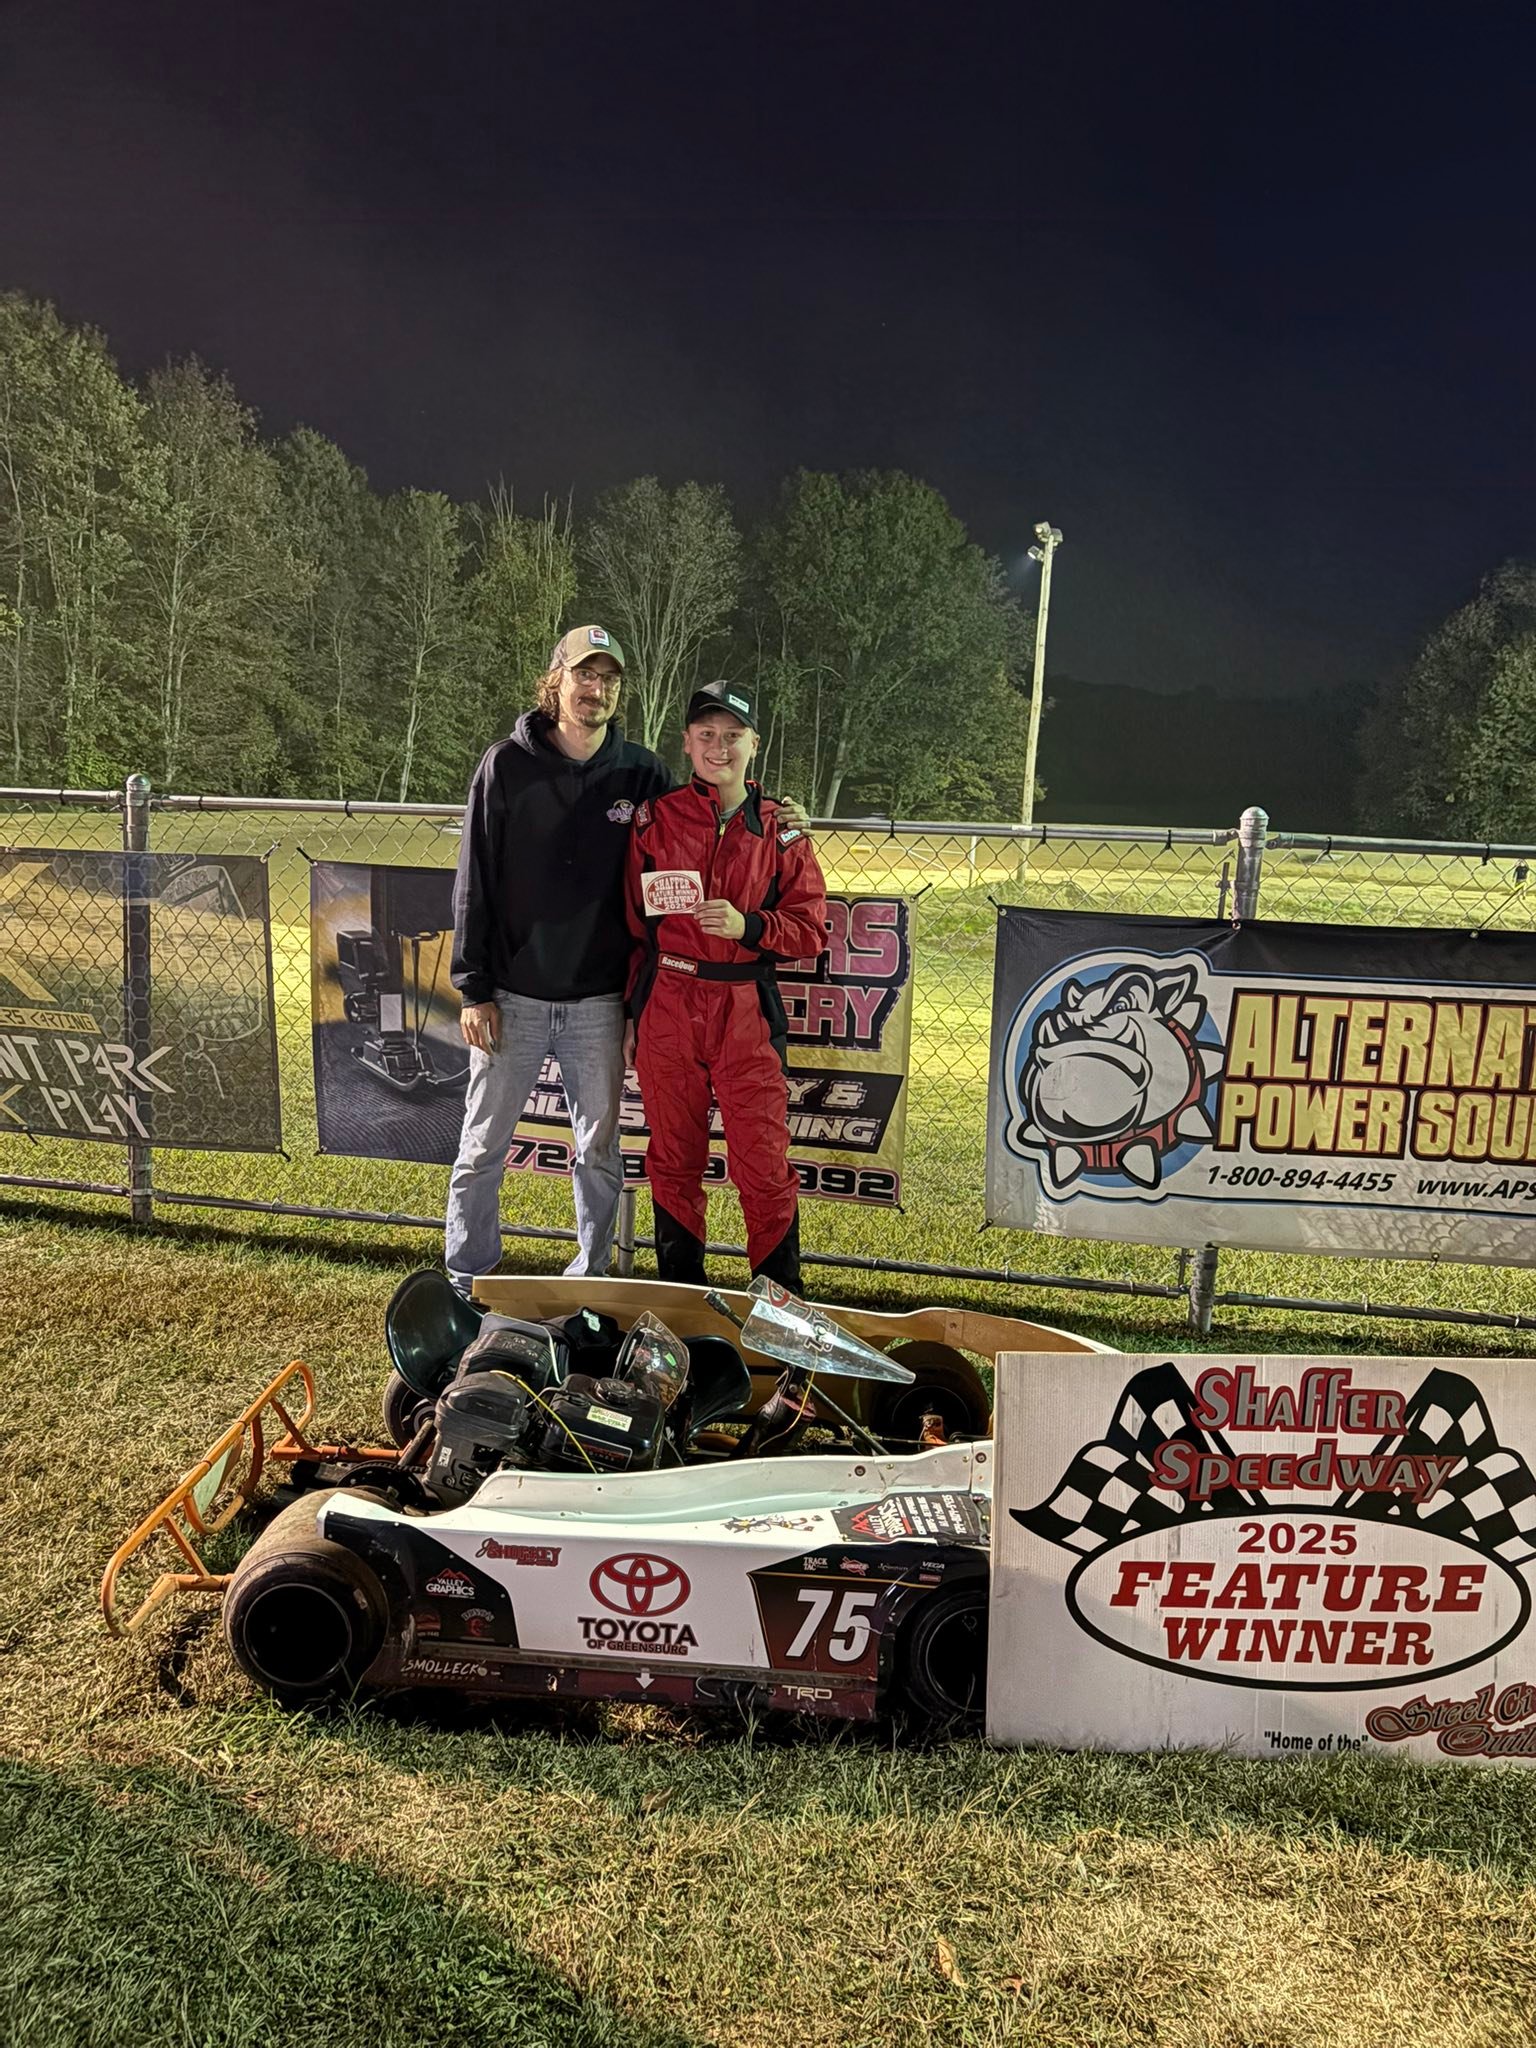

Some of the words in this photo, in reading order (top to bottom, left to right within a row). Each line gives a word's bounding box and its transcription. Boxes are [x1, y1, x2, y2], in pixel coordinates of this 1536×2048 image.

[649, 890, 674, 899] FEATURE
[675, 889, 698, 897] WINNER
[654, 877, 691, 890] SHAFFER
[653, 895, 696, 905] SPEEDWAY
[1228, 993, 1536, 1089] ALTERNA
[54, 1037, 177, 1093] PARK
[38, 1086, 150, 1139] PLAY
[1219, 1084, 1404, 1154] POWER
[1415, 1091, 1536, 1160] SOU
[1208, 1166, 1396, 1192] 1-800-894-4455
[1238, 1523, 1357, 1556] 2025
[803, 1556, 828, 1566] TRACK
[922, 1561, 945, 1570] VEGA
[425, 1583, 475, 1597] GRAPHICS
[436, 1577, 465, 1587] VALLEY
[1109, 1561, 1488, 1613] FEATURE
[577, 1616, 699, 1648] TOYOTA
[785, 1588, 879, 1662] 75
[586, 1639, 605, 1650] OF
[606, 1640, 689, 1656] GREENSBURG
[1162, 1618, 1434, 1665] WINNER
[782, 1684, 833, 1702] TRD
[1366, 1682, 1495, 1742] Steel
[1264, 1731, 1313, 1751] "Home
[1318, 1733, 1333, 1751] of
[1337, 1734, 1369, 1751] the"
